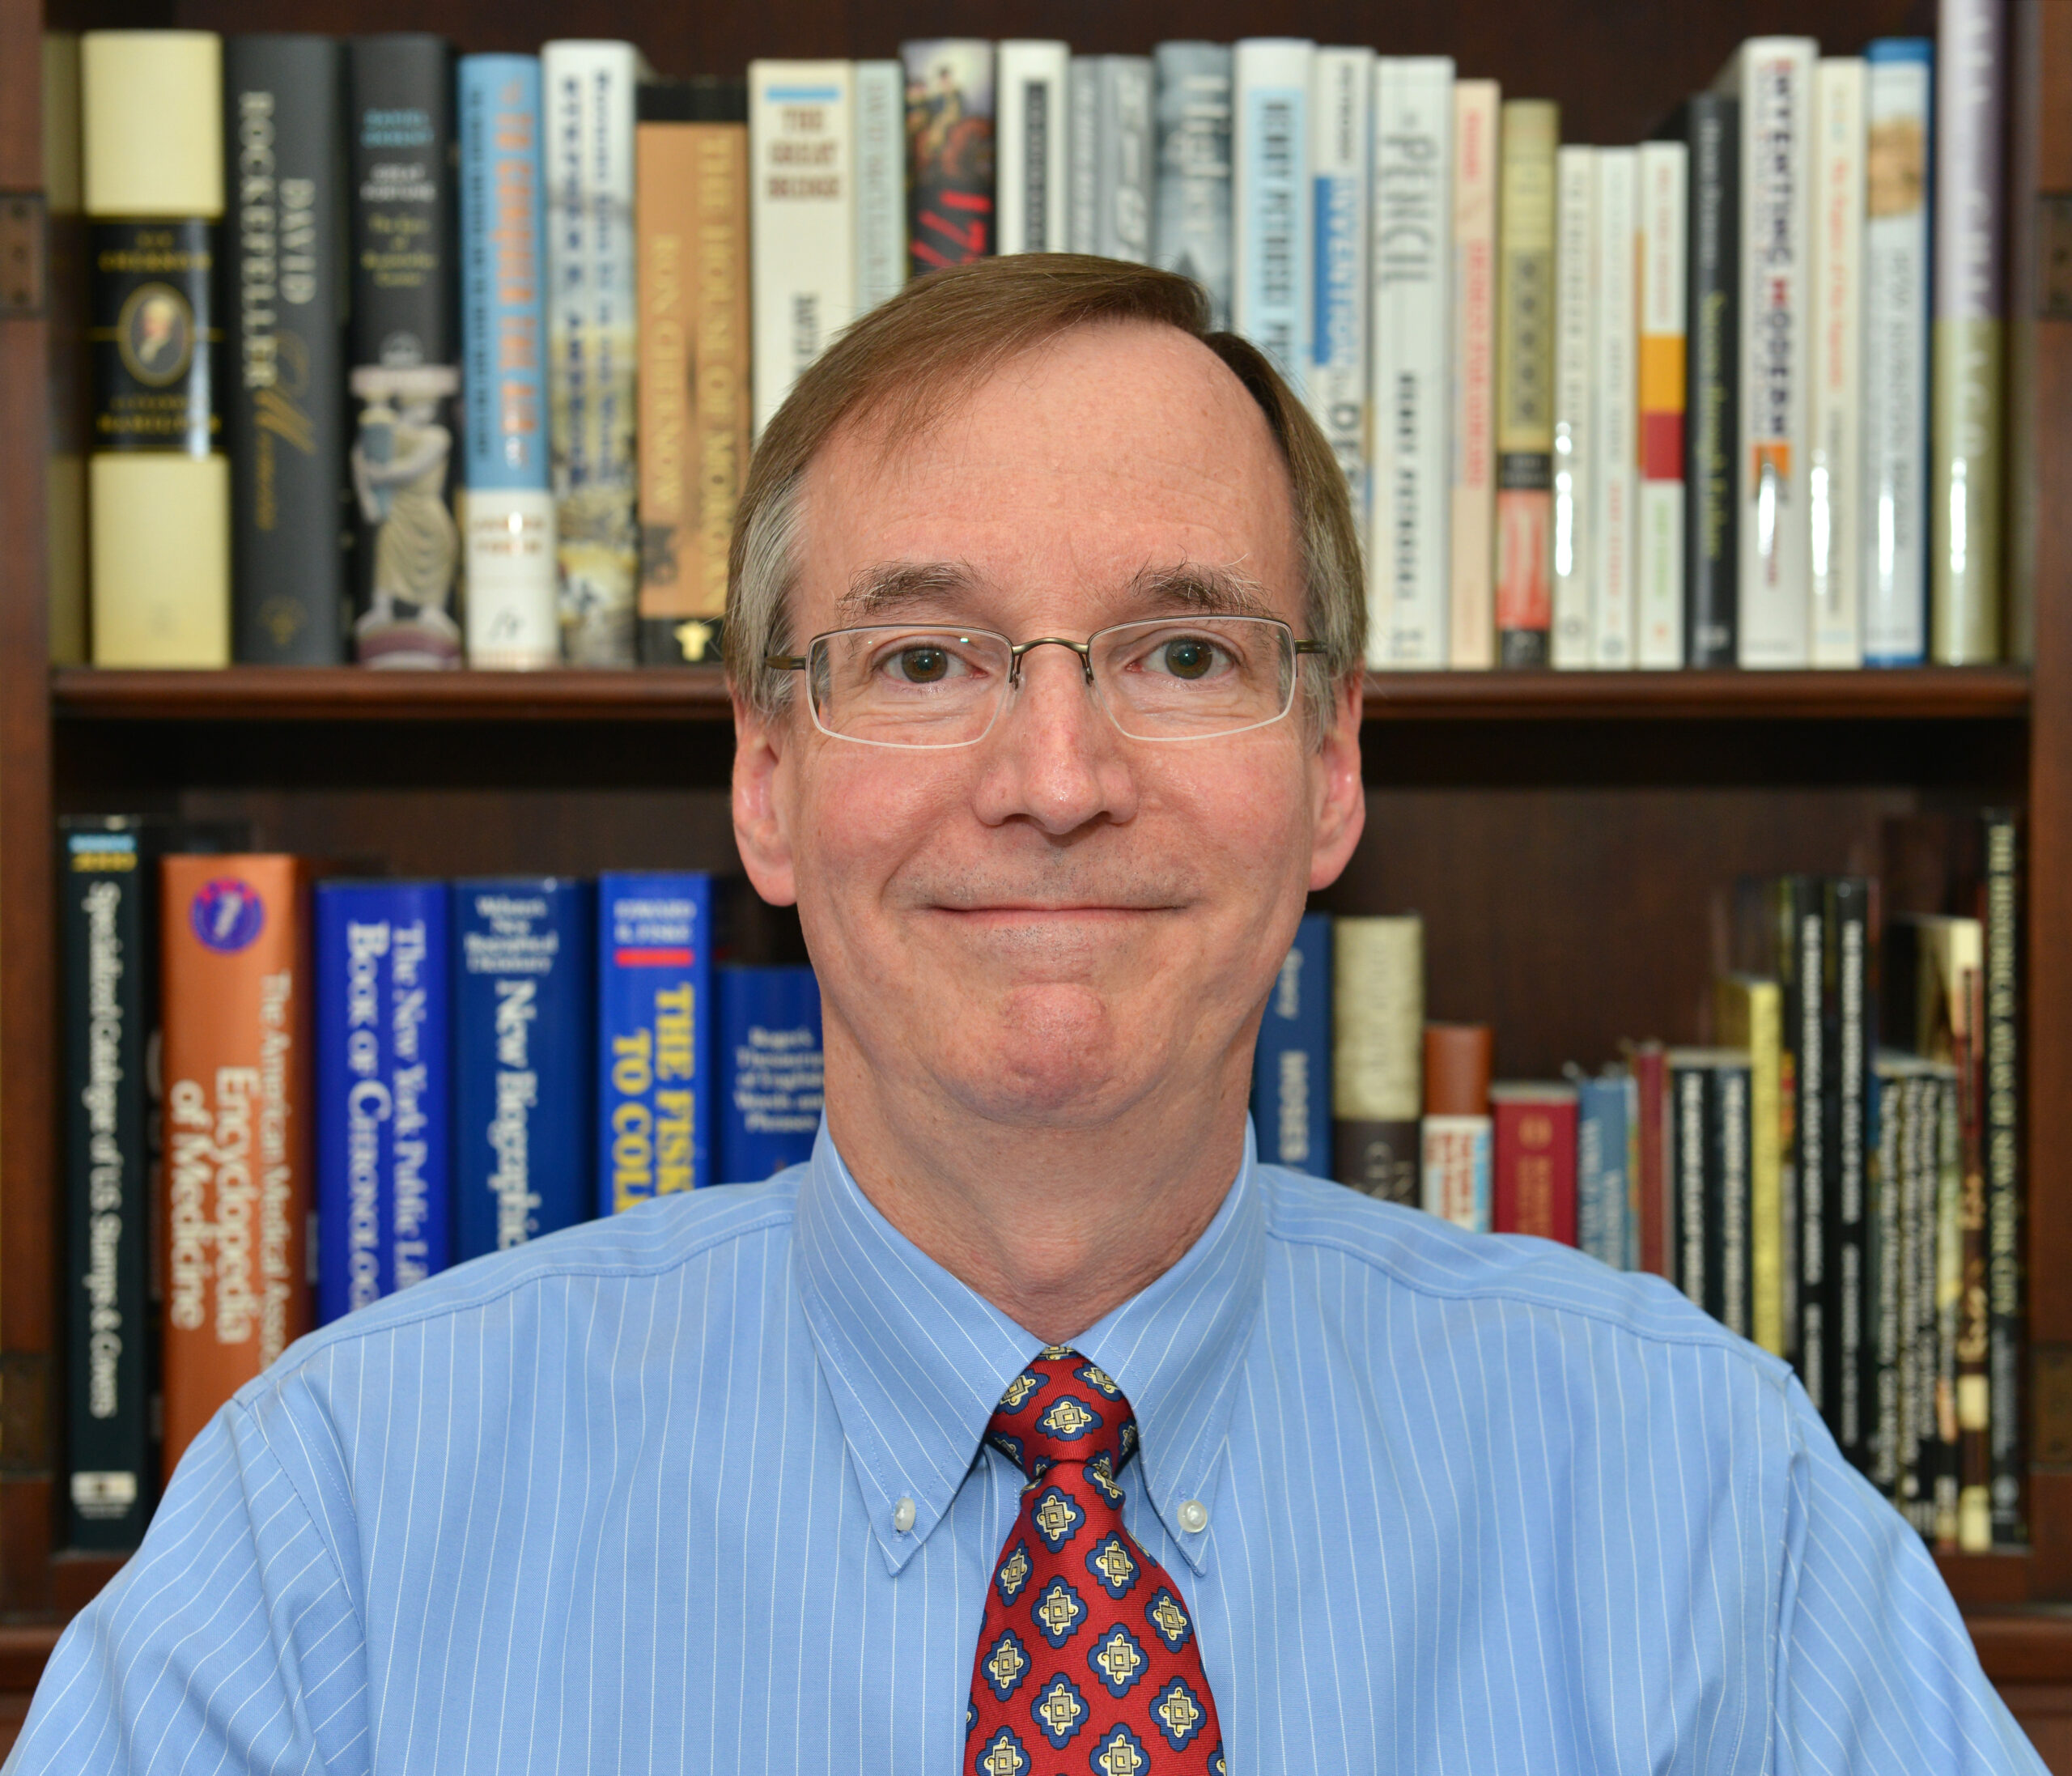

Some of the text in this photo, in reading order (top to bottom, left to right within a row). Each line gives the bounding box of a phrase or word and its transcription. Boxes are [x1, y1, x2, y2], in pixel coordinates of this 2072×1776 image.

[1265, 102, 1294, 176] HENRY
[240, 91, 275, 389] ROCKEFELLER
[280, 179, 316, 304] DAVID
[1263, 191, 1294, 305] PETROSKI
[1331, 178, 1360, 367] INVENTION
[649, 235, 683, 507] RON CHERNOW
[697, 138, 735, 607] THE HOUSE OF MORGAN
[1379, 134, 1440, 599] PENCIL HENRY PETROSKI
[1989, 826, 2015, 871] THE
[82, 882, 124, 1019] Specialized
[393, 920, 427, 985] The
[1989, 877, 2016, 1017] HISTORICAL
[261, 971, 291, 1026] The
[394, 989, 427, 1062] New
[496, 979, 537, 1068] New
[656, 983, 694, 1080] THE
[81, 1022, 124, 1133] Catalogue
[260, 1030, 291, 1162] American
[394, 1064, 427, 1137] York
[613, 1029, 652, 1095] TO
[1989, 1023, 2016, 1090] ATLAS
[90, 1134, 124, 1166] of
[1280, 1050, 1308, 1161] MOSES
[1989, 1091, 2016, 1126] OF
[394, 1141, 428, 1235] Public
[1990, 1131, 2016, 1186] NEW
[172, 1081, 214, 1330] of Medicine
[211, 1067, 261, 1344] Encyclopedia
[260, 1166, 291, 1277] Medical
[1991, 1189, 2016, 1253] YORK
[82, 1213, 122, 1306] Stamps
[1992, 1256, 2018, 1315] CITY
[89, 1307, 121, 1332] &
[91, 1332, 121, 1417] Covers
